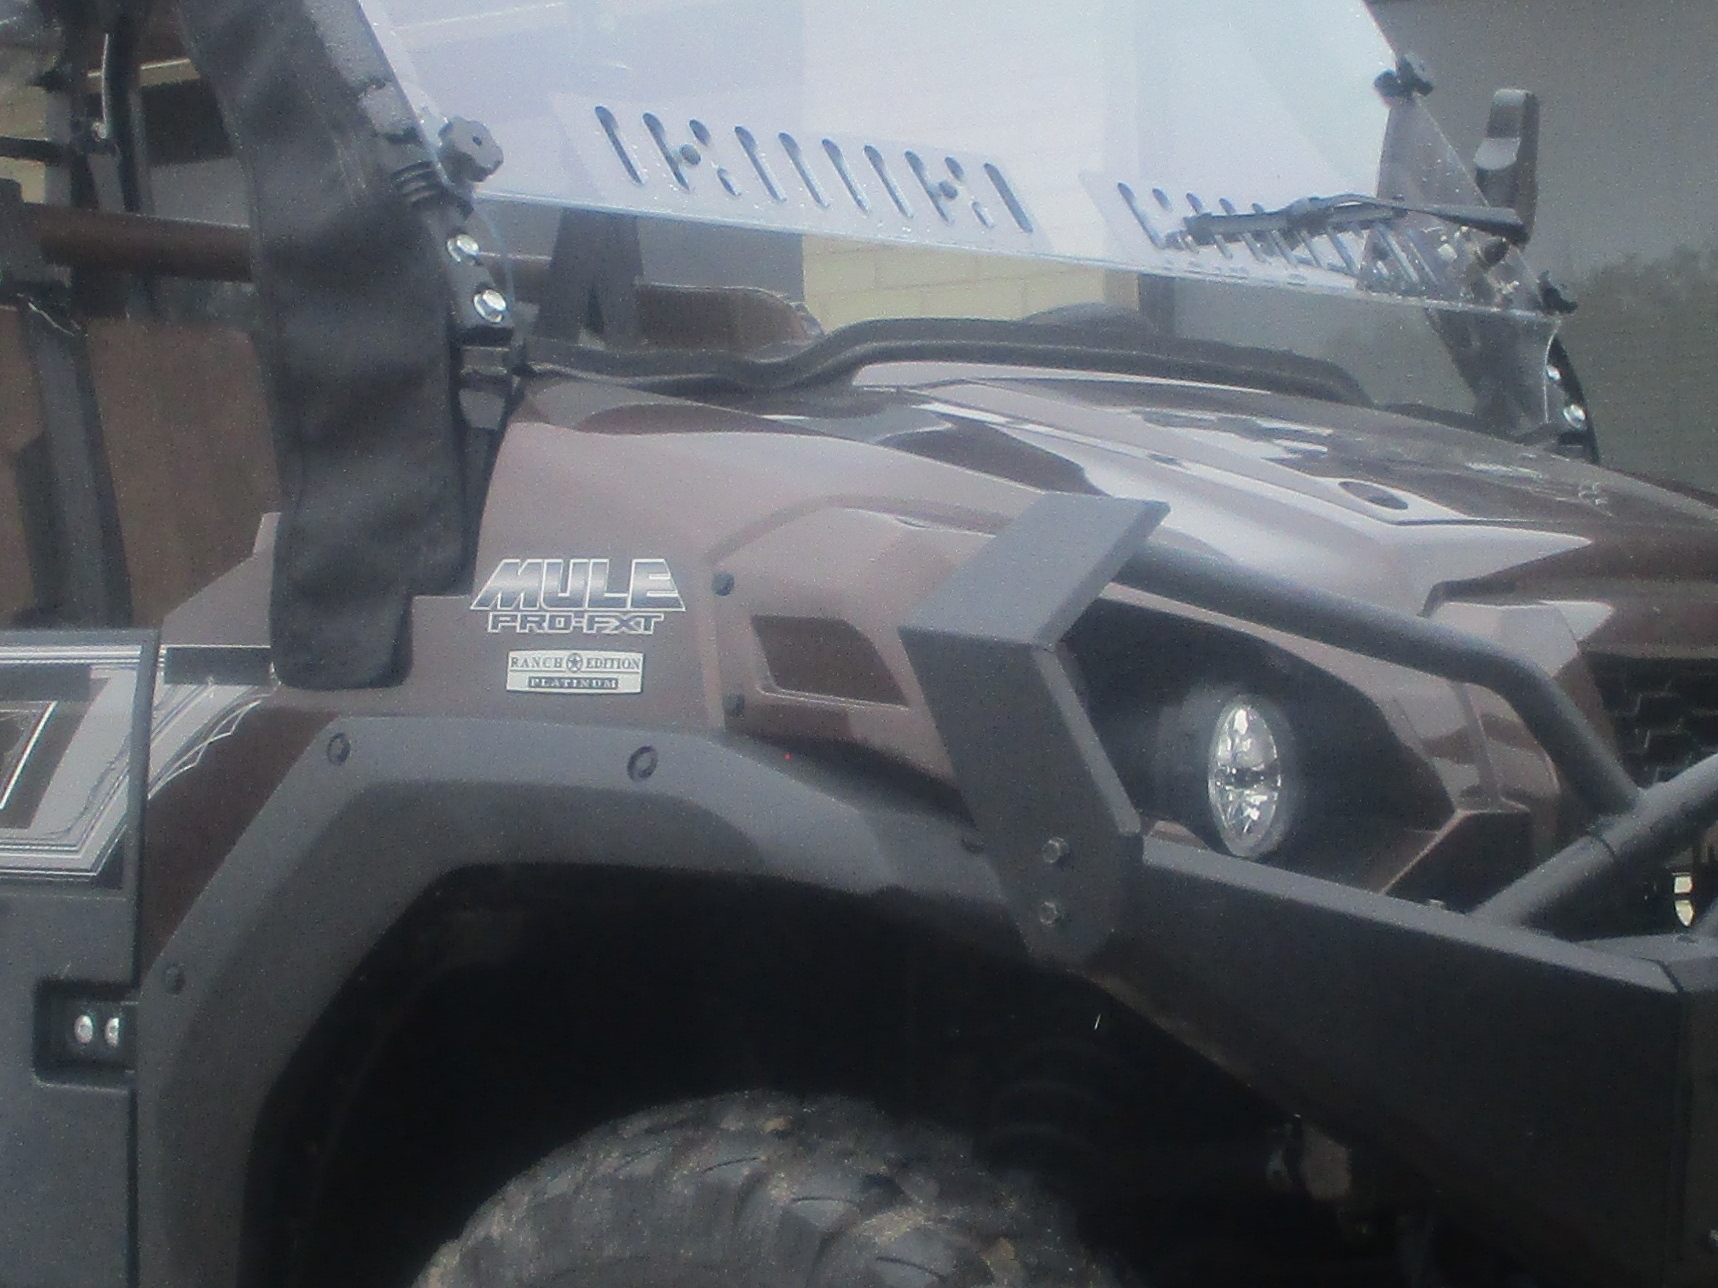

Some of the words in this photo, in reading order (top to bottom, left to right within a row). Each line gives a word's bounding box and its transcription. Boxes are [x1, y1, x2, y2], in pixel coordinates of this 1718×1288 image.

[470, 558, 686, 612] MULE
[487, 611, 665, 634] PRO-FXT
[509, 655, 563, 669] RANCH
[585, 656, 641, 670] EDITION
[529, 677, 618, 689] PLATINUM
